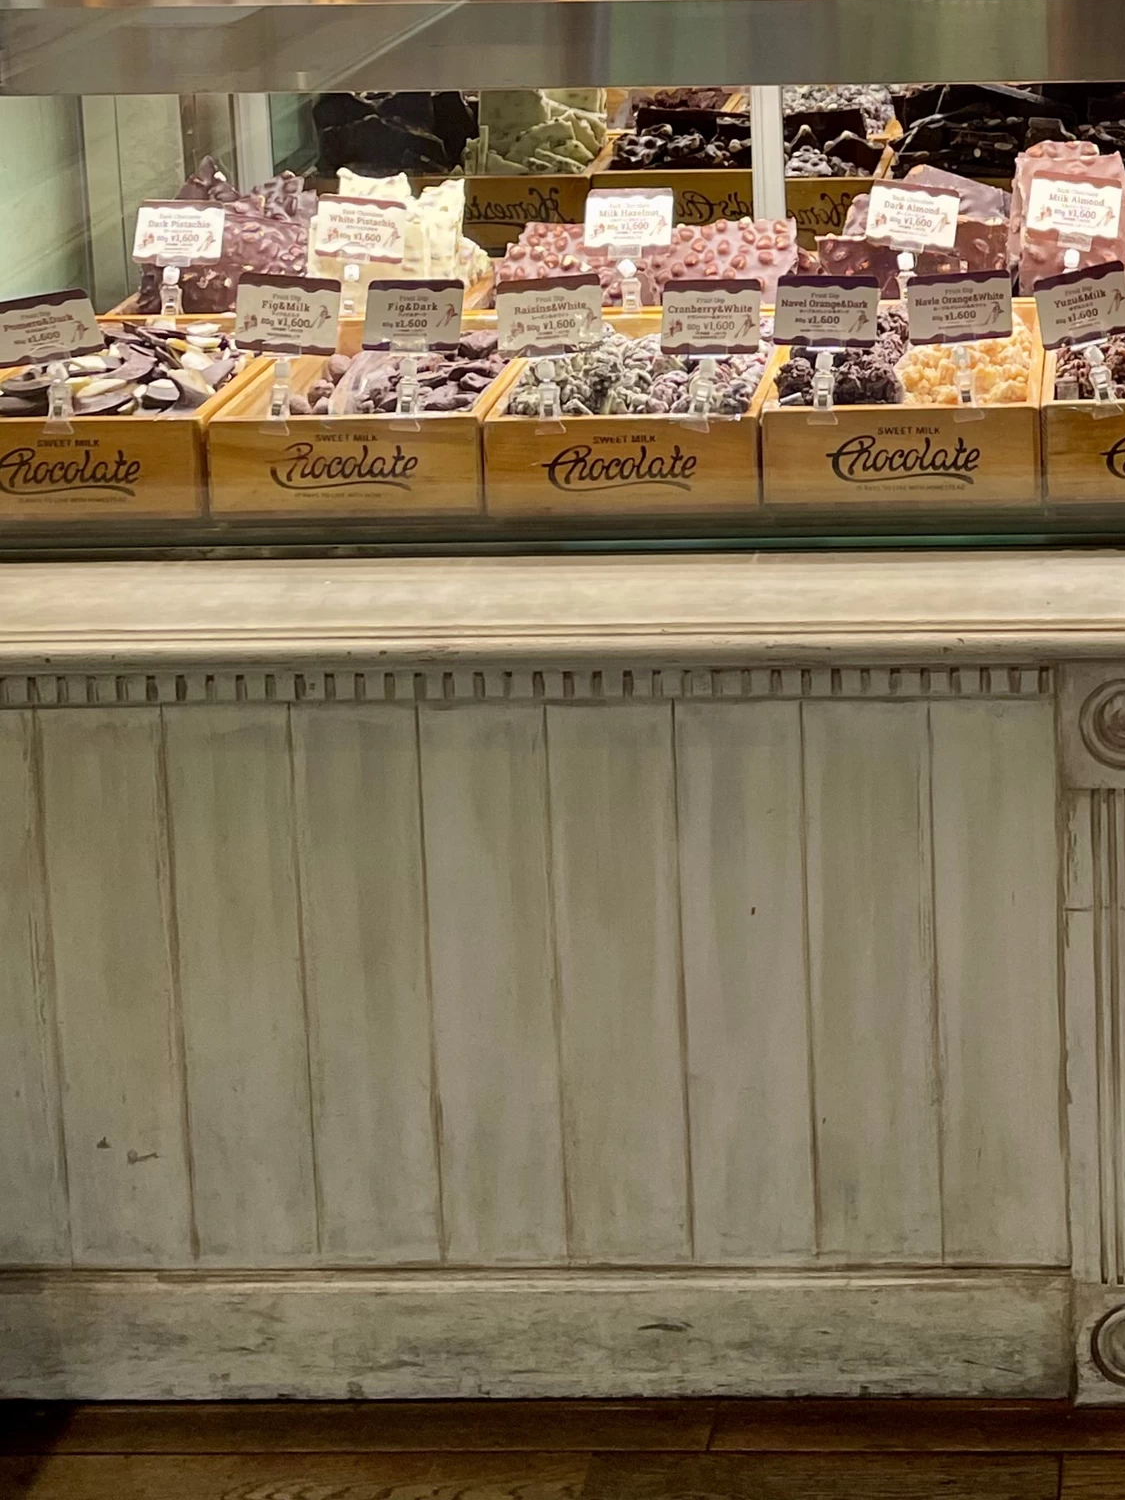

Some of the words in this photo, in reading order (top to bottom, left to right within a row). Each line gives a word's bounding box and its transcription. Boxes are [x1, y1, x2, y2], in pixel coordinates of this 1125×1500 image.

[884, 200, 904, 211] Dark
[906, 203, 941, 215] Almond
[1049, 194, 1069, 203] Milk
[1071, 196, 1105, 208] Almond
[781, 299, 807, 308] Navel
[808, 300, 868, 310] Orange&Dark
[1054, 290, 1107, 308] Yuzu&Milk
[261, 300, 311, 313] Fig&Milk
[387, 302, 438, 314] Fig&Dark
[668, 304, 753, 315] Cranberry&White
[877, 427, 912, 435] SWEET
[915, 426, 940, 435] MILK
[826, 435, 981, 477] Chocolate
[0, 447, 141, 491] Chocolate
[272, 443, 418, 486] Chocolate
[543, 445, 697, 486] Chocolate
